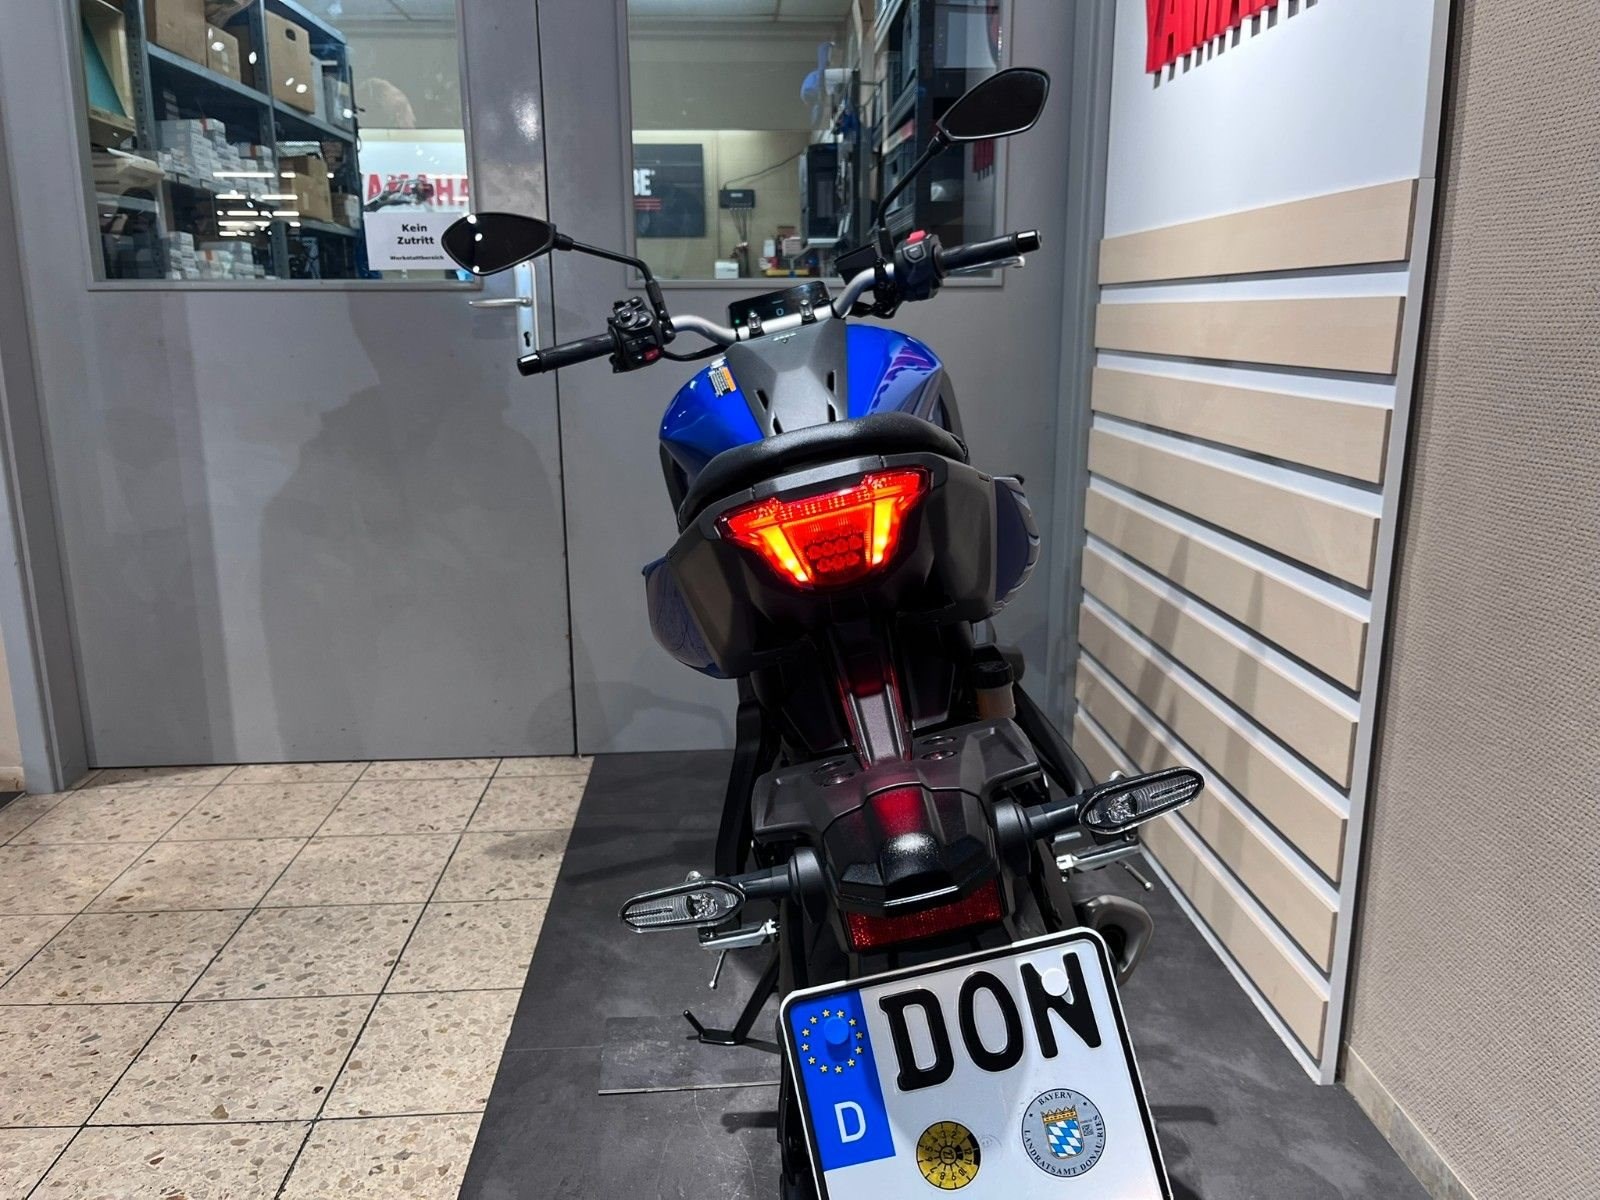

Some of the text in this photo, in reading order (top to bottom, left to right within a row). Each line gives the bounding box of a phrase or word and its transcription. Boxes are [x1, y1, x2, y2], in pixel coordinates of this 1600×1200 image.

[397, 236, 435, 245] Zutritt
[401, 223, 428, 233] Kein
[879, 952, 1102, 1091] DON
[1038, 1091, 1073, 1106] BAYERN
[834, 1101, 867, 1143] D
[1024, 1114, 1105, 1175] LANDRATSAMT DONAU-RIES
